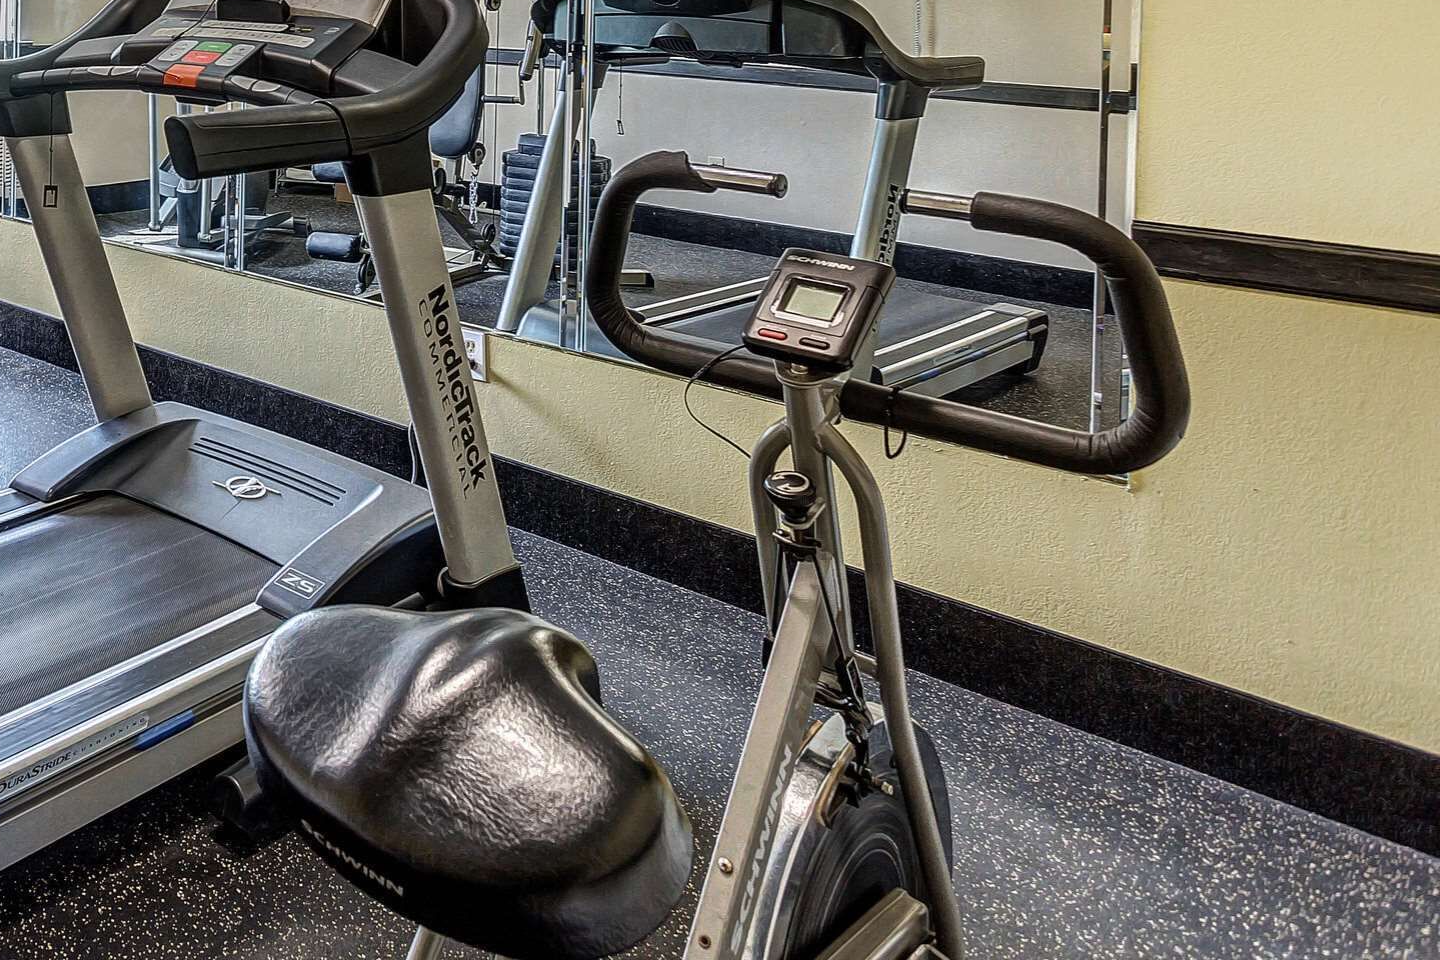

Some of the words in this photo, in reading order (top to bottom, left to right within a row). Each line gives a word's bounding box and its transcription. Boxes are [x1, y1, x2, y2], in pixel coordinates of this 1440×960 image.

[786, 254, 856, 271] SCHWINN
[418, 299, 470, 500] COMMERCIAL
[428, 284, 486, 490] NordicTrack
[300, 818, 404, 897] SCHWINN
[730, 743, 793, 955] SCHWINN
